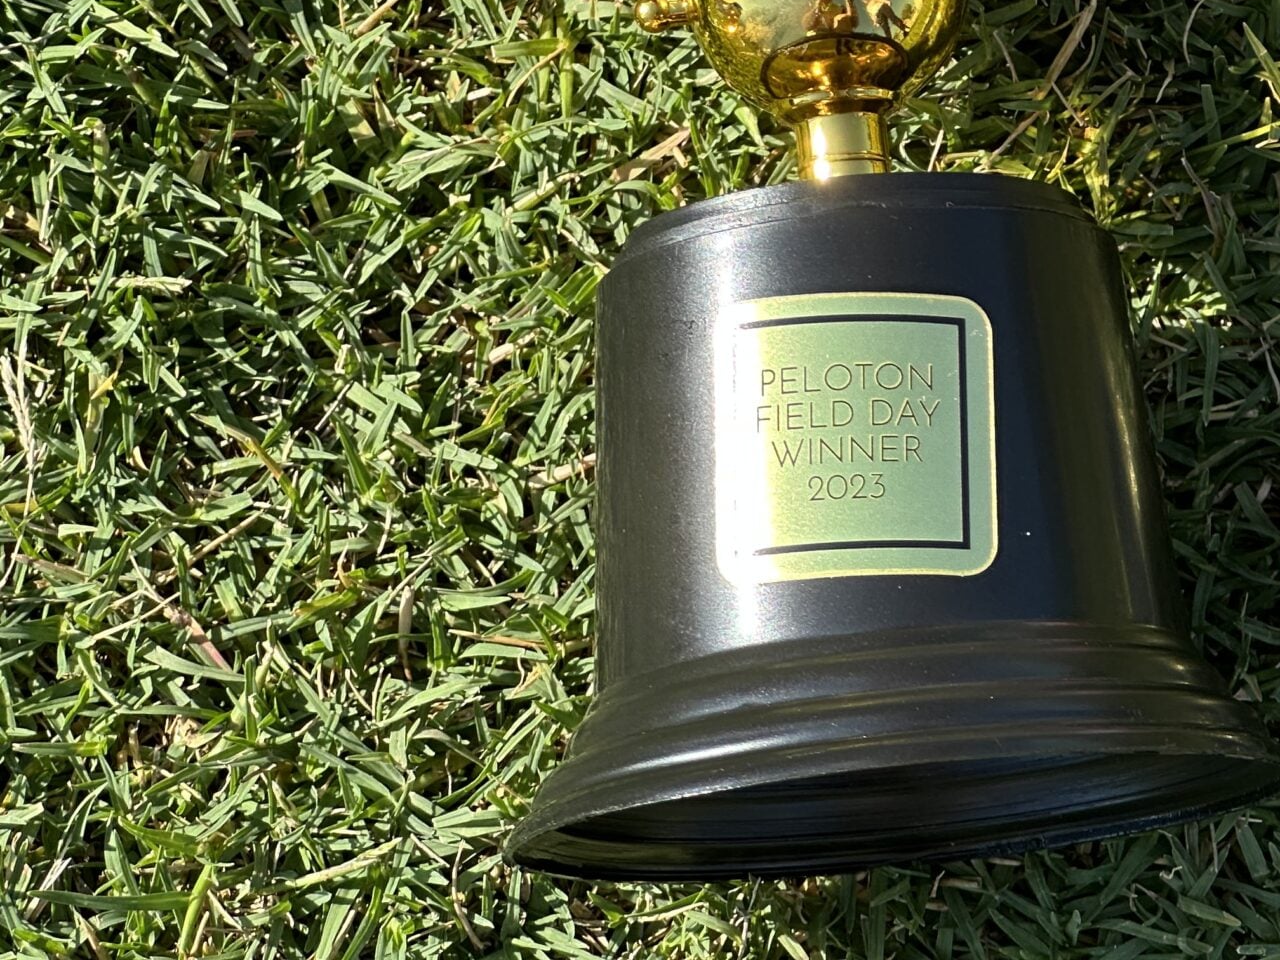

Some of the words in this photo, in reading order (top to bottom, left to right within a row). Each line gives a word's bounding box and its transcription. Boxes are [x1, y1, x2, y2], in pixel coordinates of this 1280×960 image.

[761, 362, 933, 396] PELOTON
[757, 400, 854, 433] FIELD
[871, 399, 941, 427] DAY
[772, 435, 923, 468] WINNER
[808, 473, 886, 501] 2023
